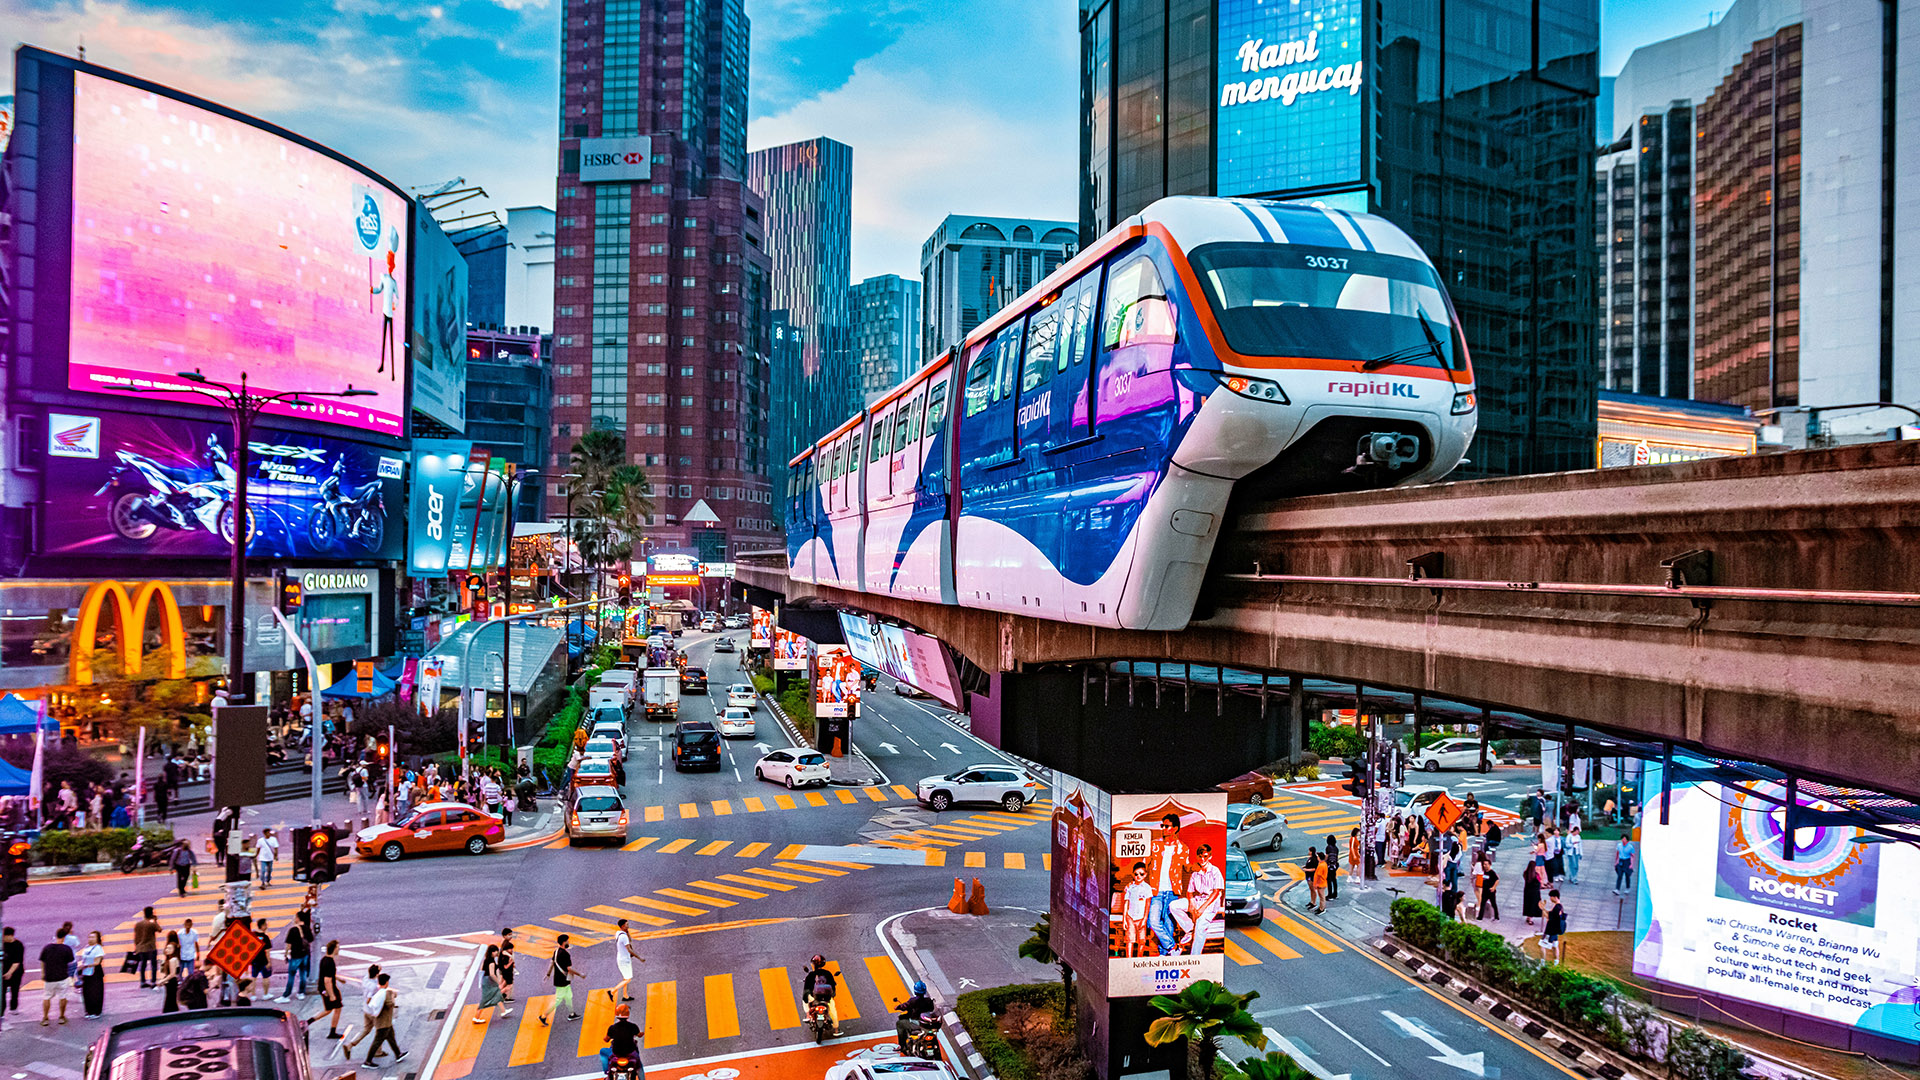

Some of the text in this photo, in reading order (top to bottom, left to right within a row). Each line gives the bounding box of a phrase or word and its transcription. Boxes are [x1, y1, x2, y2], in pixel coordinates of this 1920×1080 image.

[1238, 30, 1319, 73] Kami
[583, 153, 621, 166] HSBC
[1305, 255, 1349, 270] 3037
[1114, 372, 1133, 397] 3037
[1328, 381, 1420, 399] rapidKL
[54, 445, 92, 453] HONDA
[427, 484, 444, 541] acer
[303, 572, 368, 591] GIORDANO
[1123, 832, 1143, 840] KEMEJA
[1121, 844, 1146, 856] RM59
[1748, 876, 1839, 906] ROCKET
[1769, 913, 1818, 932] Rocket
[1706, 917, 1880, 958] with Christina Warren, Brianna Wu
[1732, 932, 1850, 965] & Simone de Rochefort
[1133, 959, 1200, 968] Koleksi Ramadan
[1714, 941, 1871, 983] Geek out about tech and geek
[1155, 968, 1191, 980] max
[1715, 956, 1868, 996] culture with the first and most
[1707, 966, 1874, 1010] popular all-female tech podcast.
